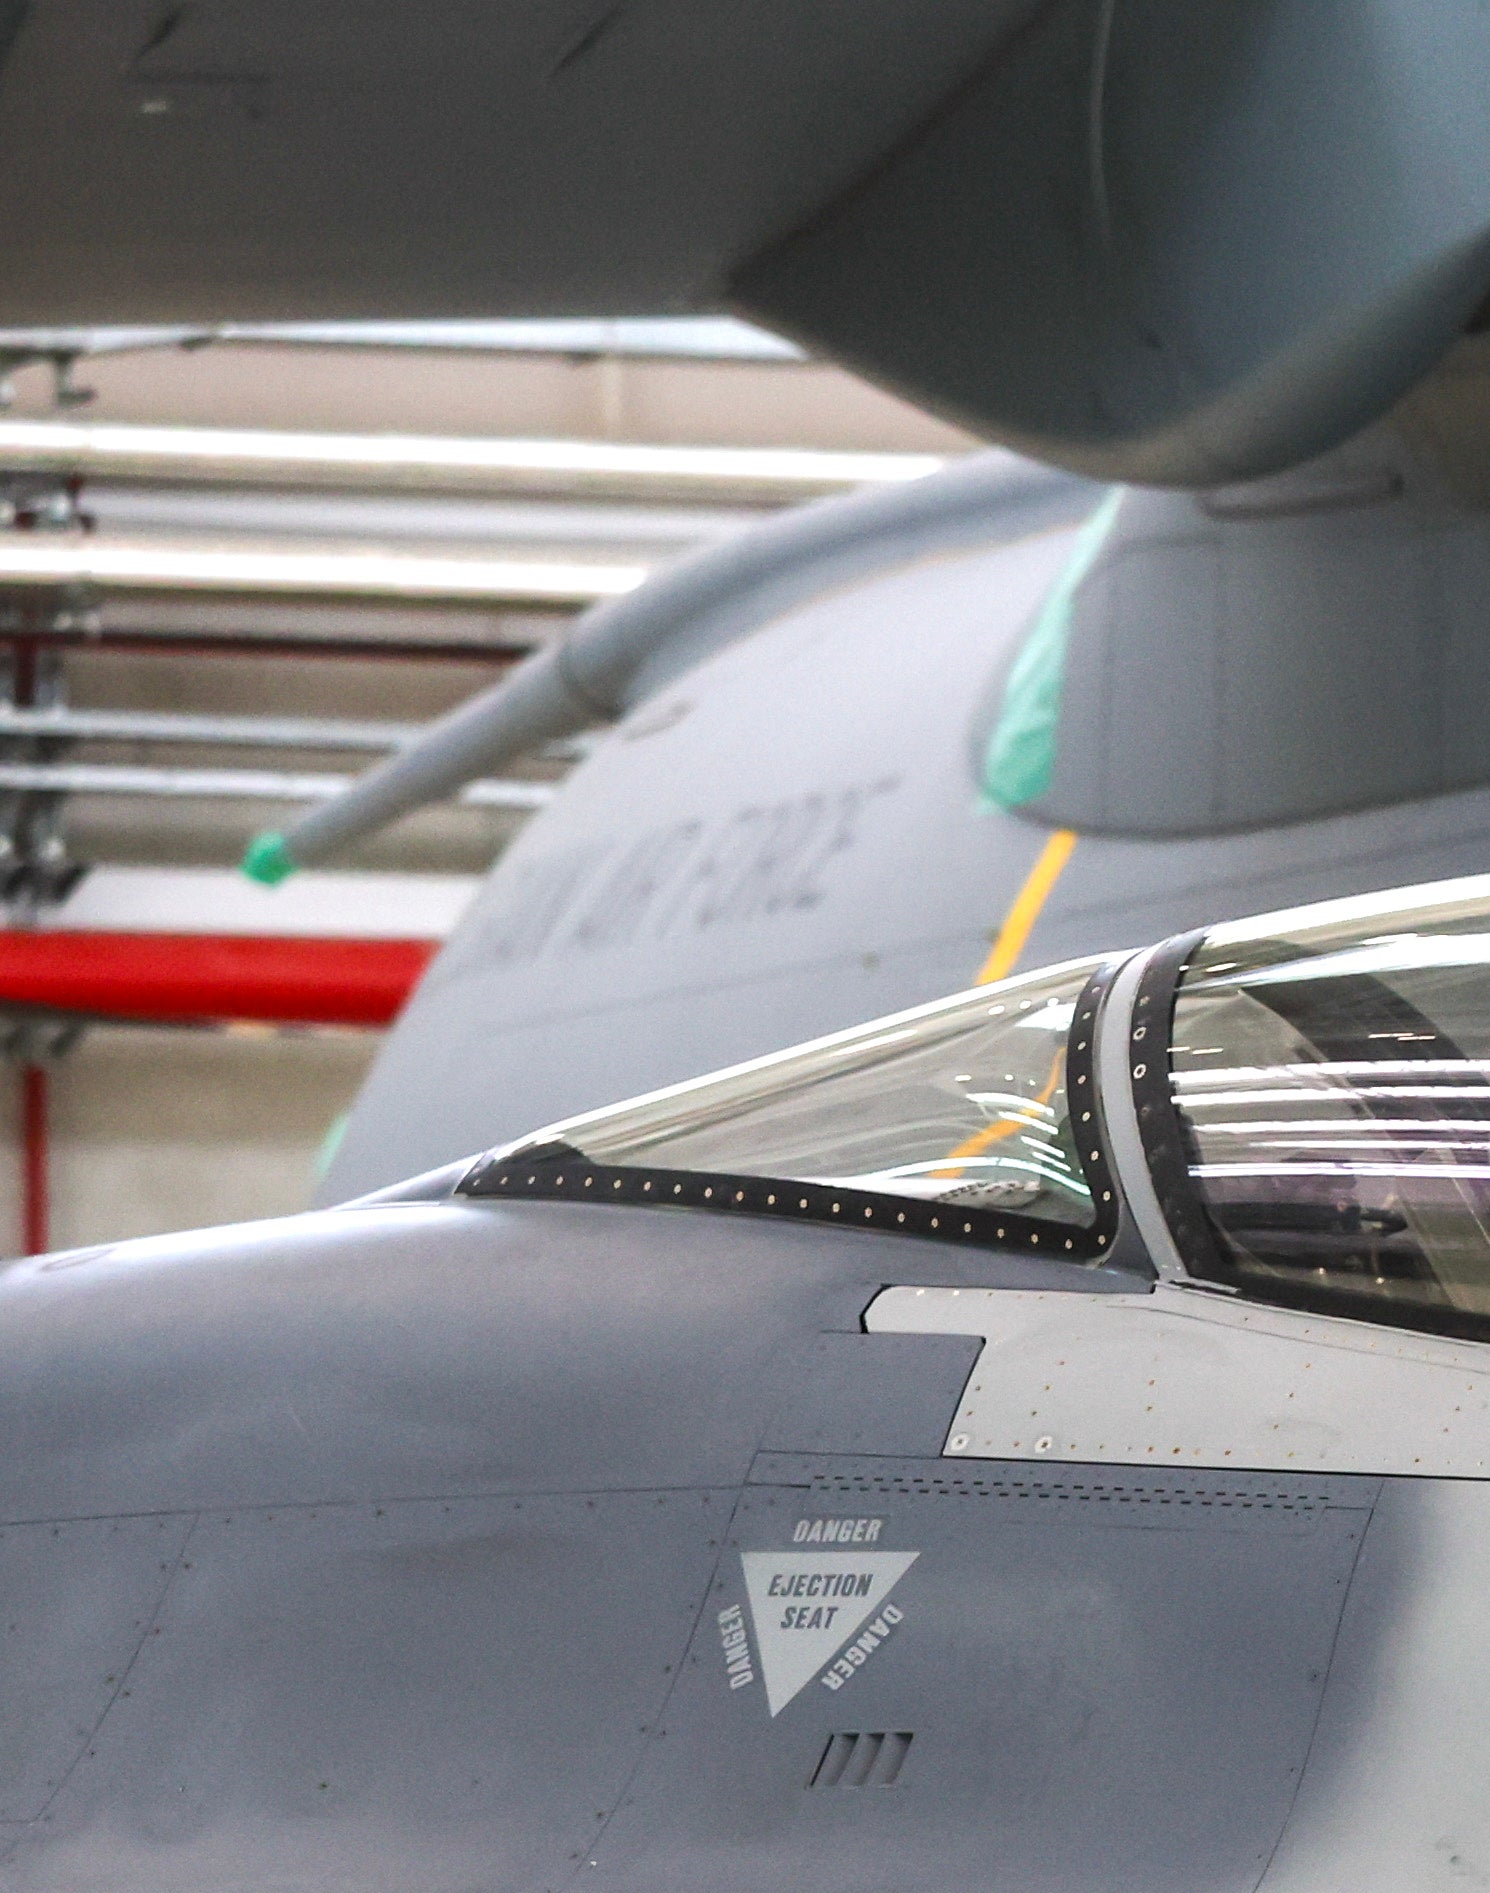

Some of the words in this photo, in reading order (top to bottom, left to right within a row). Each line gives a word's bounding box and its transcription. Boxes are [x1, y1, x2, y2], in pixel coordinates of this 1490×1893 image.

[793, 1518, 882, 1543] DANGER
[767, 1574, 872, 1597] EJECTION
[780, 1606, 838, 1630] SEAT
[717, 1604, 754, 1690] DANGER
[821, 1603, 905, 1690] DANGER
